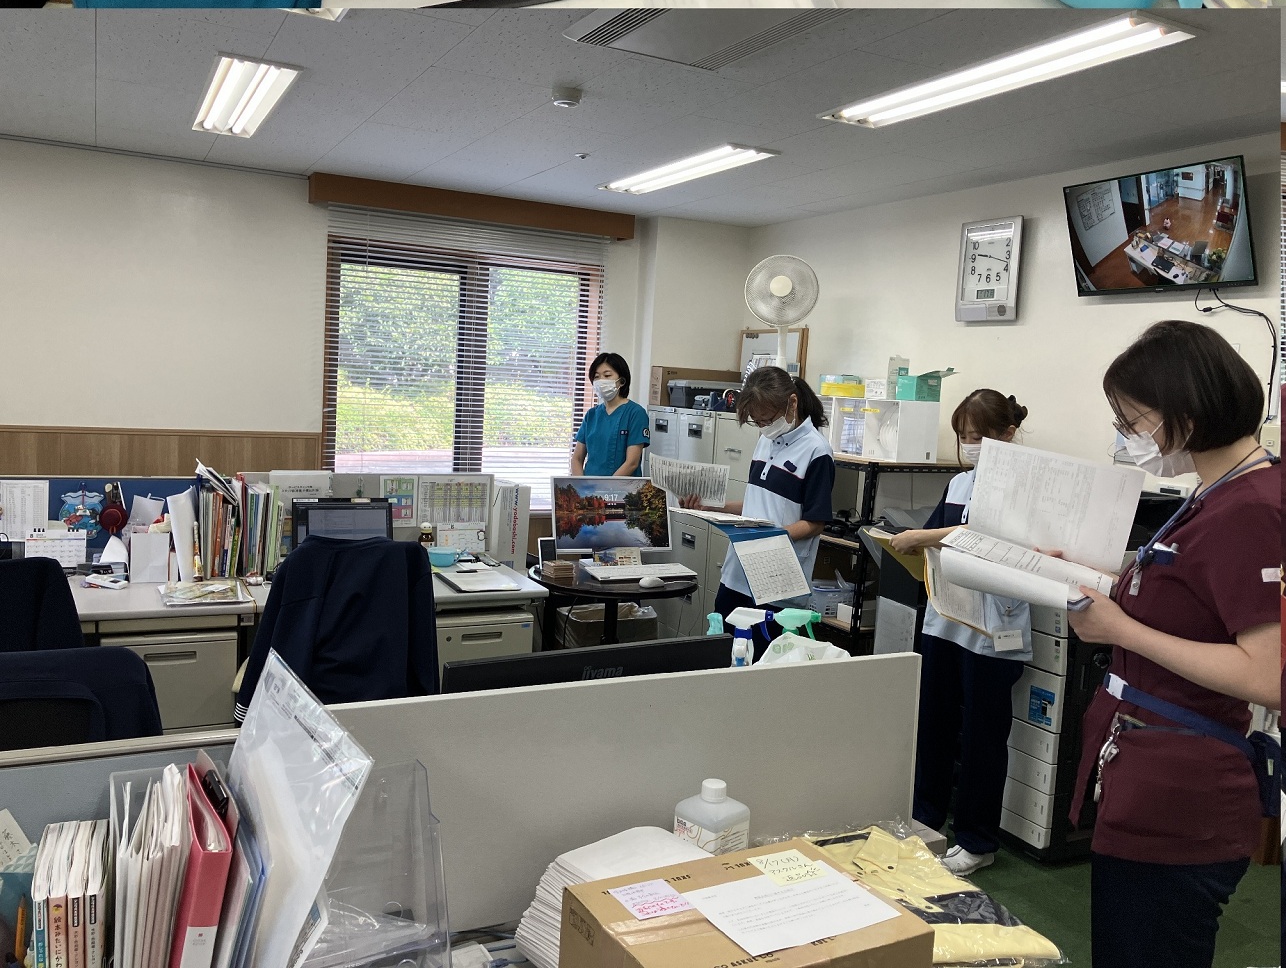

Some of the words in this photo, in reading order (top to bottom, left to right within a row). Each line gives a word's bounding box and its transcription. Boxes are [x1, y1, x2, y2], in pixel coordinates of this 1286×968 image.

[972, 241, 980, 251] 10
[1006, 237, 1011, 247] 2
[970, 253, 976, 263] 9
[1005, 250, 1011, 260] 3
[970, 265, 976, 275] 8
[1003, 264, 1009, 272] 4
[977, 273, 982, 283] 7
[985, 274, 991, 283] 6
[995, 272, 1001, 282] 5
[604, 493, 618, 502] 9:17
[582, 665, 624, 681] iiyama
